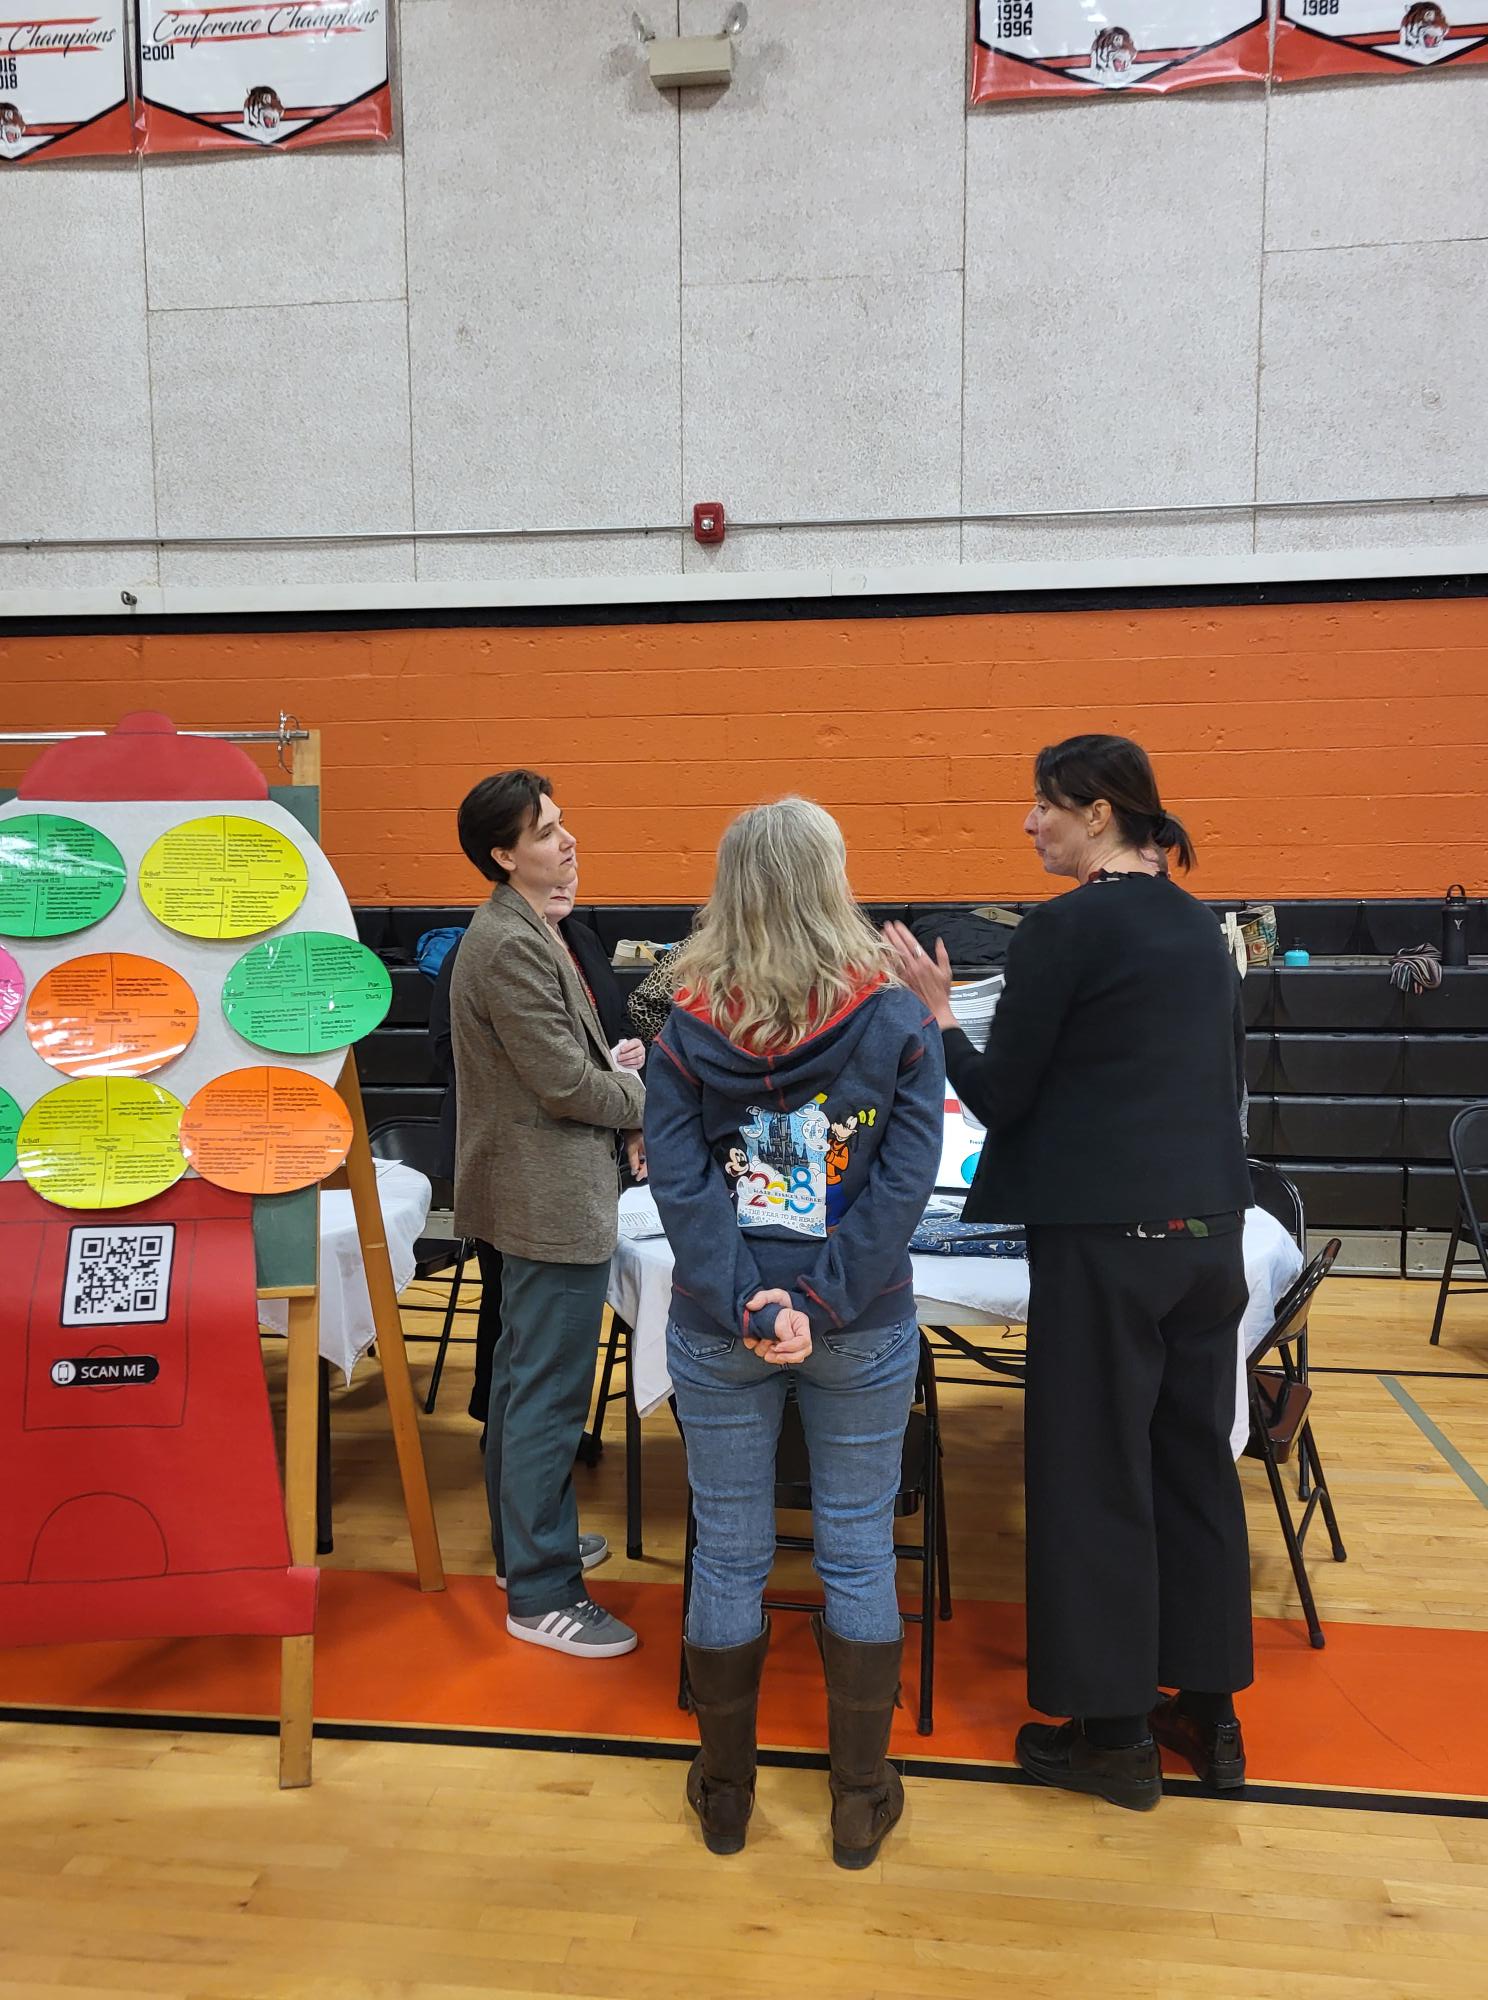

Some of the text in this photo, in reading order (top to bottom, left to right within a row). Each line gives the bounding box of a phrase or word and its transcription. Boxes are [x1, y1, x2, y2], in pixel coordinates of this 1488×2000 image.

[998, 2, 1033, 20] 1994
[153, 6, 380, 48] Conference Champions
[998, 20, 1032, 38] 1996
[8, 24, 117, 57] Champions
[142, 45, 175, 62] 2001
[748, 1166, 817, 1215] 2018
[81, 1364, 145, 1378] SCAN ME
